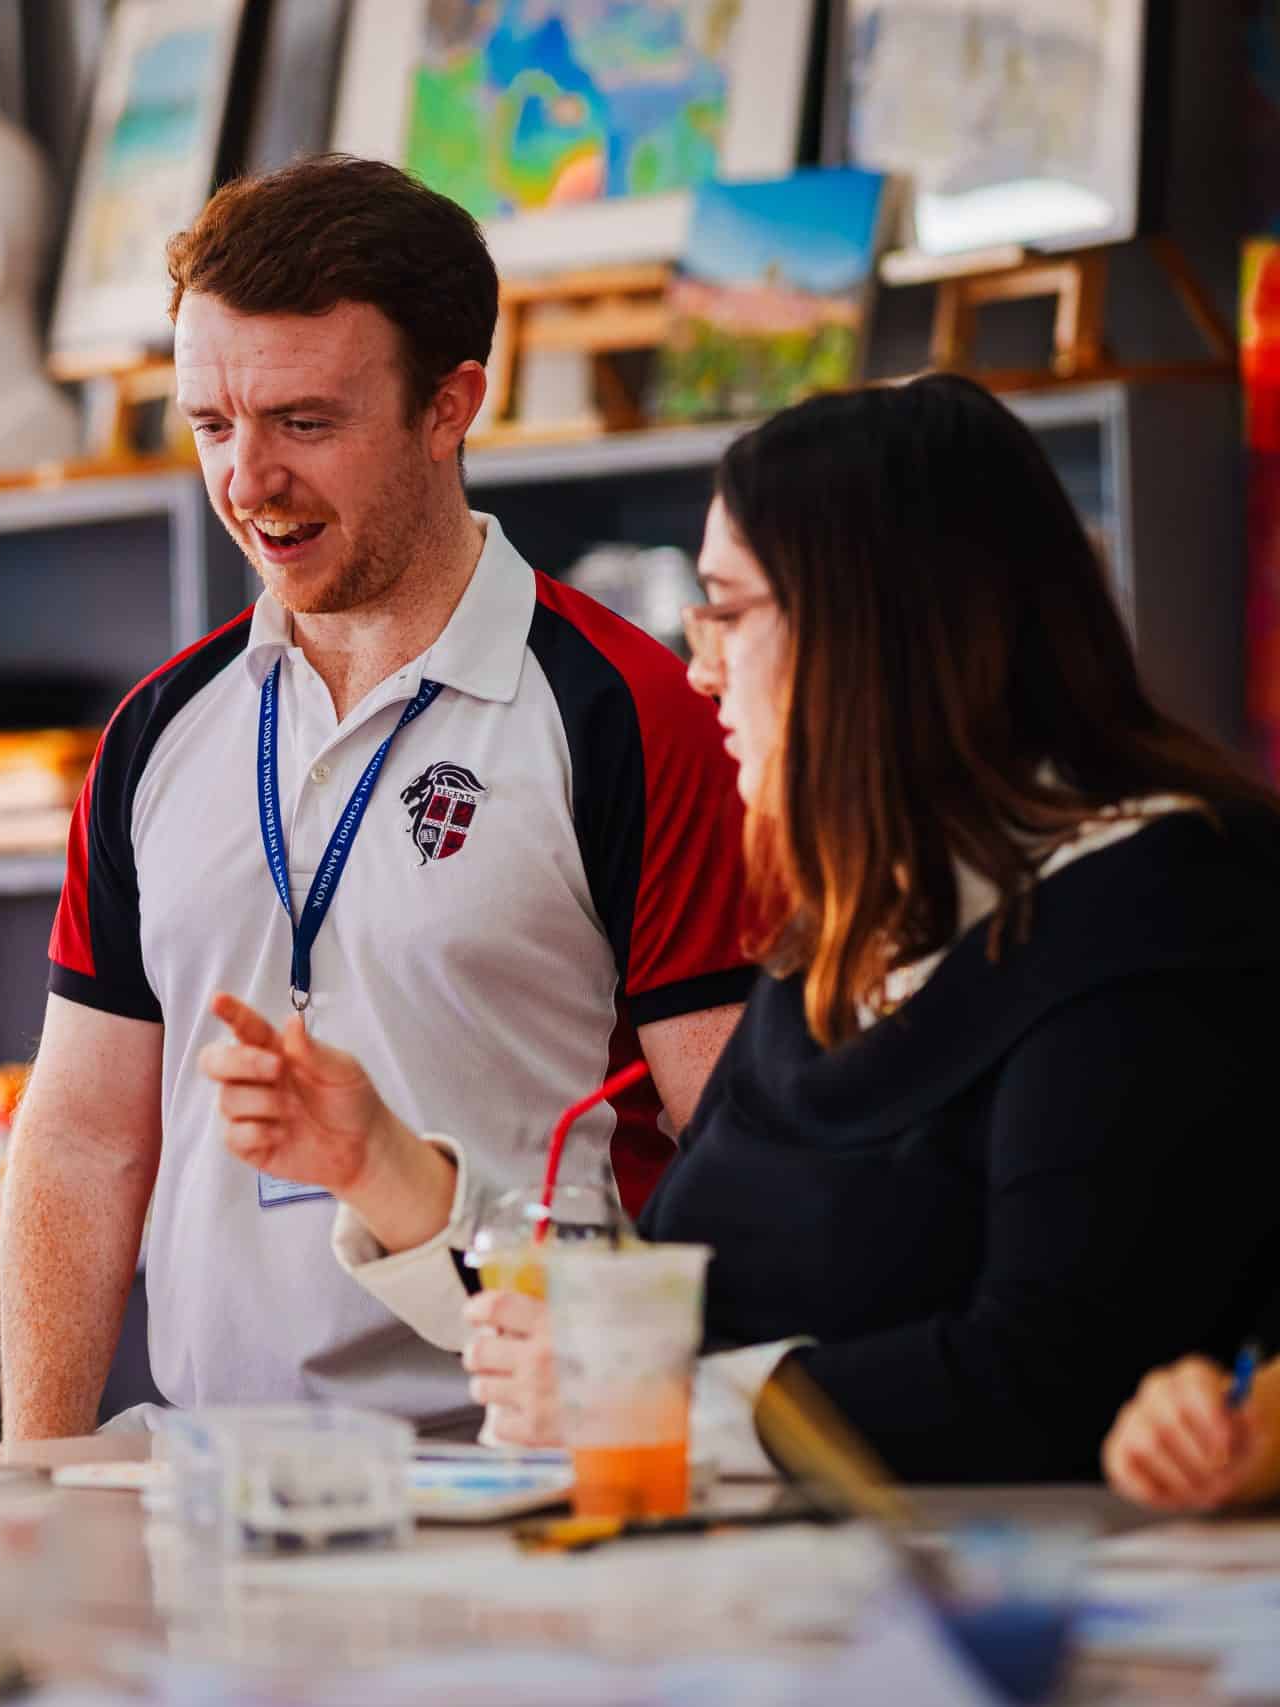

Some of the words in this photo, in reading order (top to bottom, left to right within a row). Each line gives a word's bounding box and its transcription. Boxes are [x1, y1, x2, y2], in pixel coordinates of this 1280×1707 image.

[263, 715, 273, 760] SCHOOL
[263, 761, 278, 853] INTERNATIONAL
[336, 797, 363, 846] SCHOOL
[273, 855, 291, 912] GENT'S
[312, 848, 341, 908] BANGKOK
